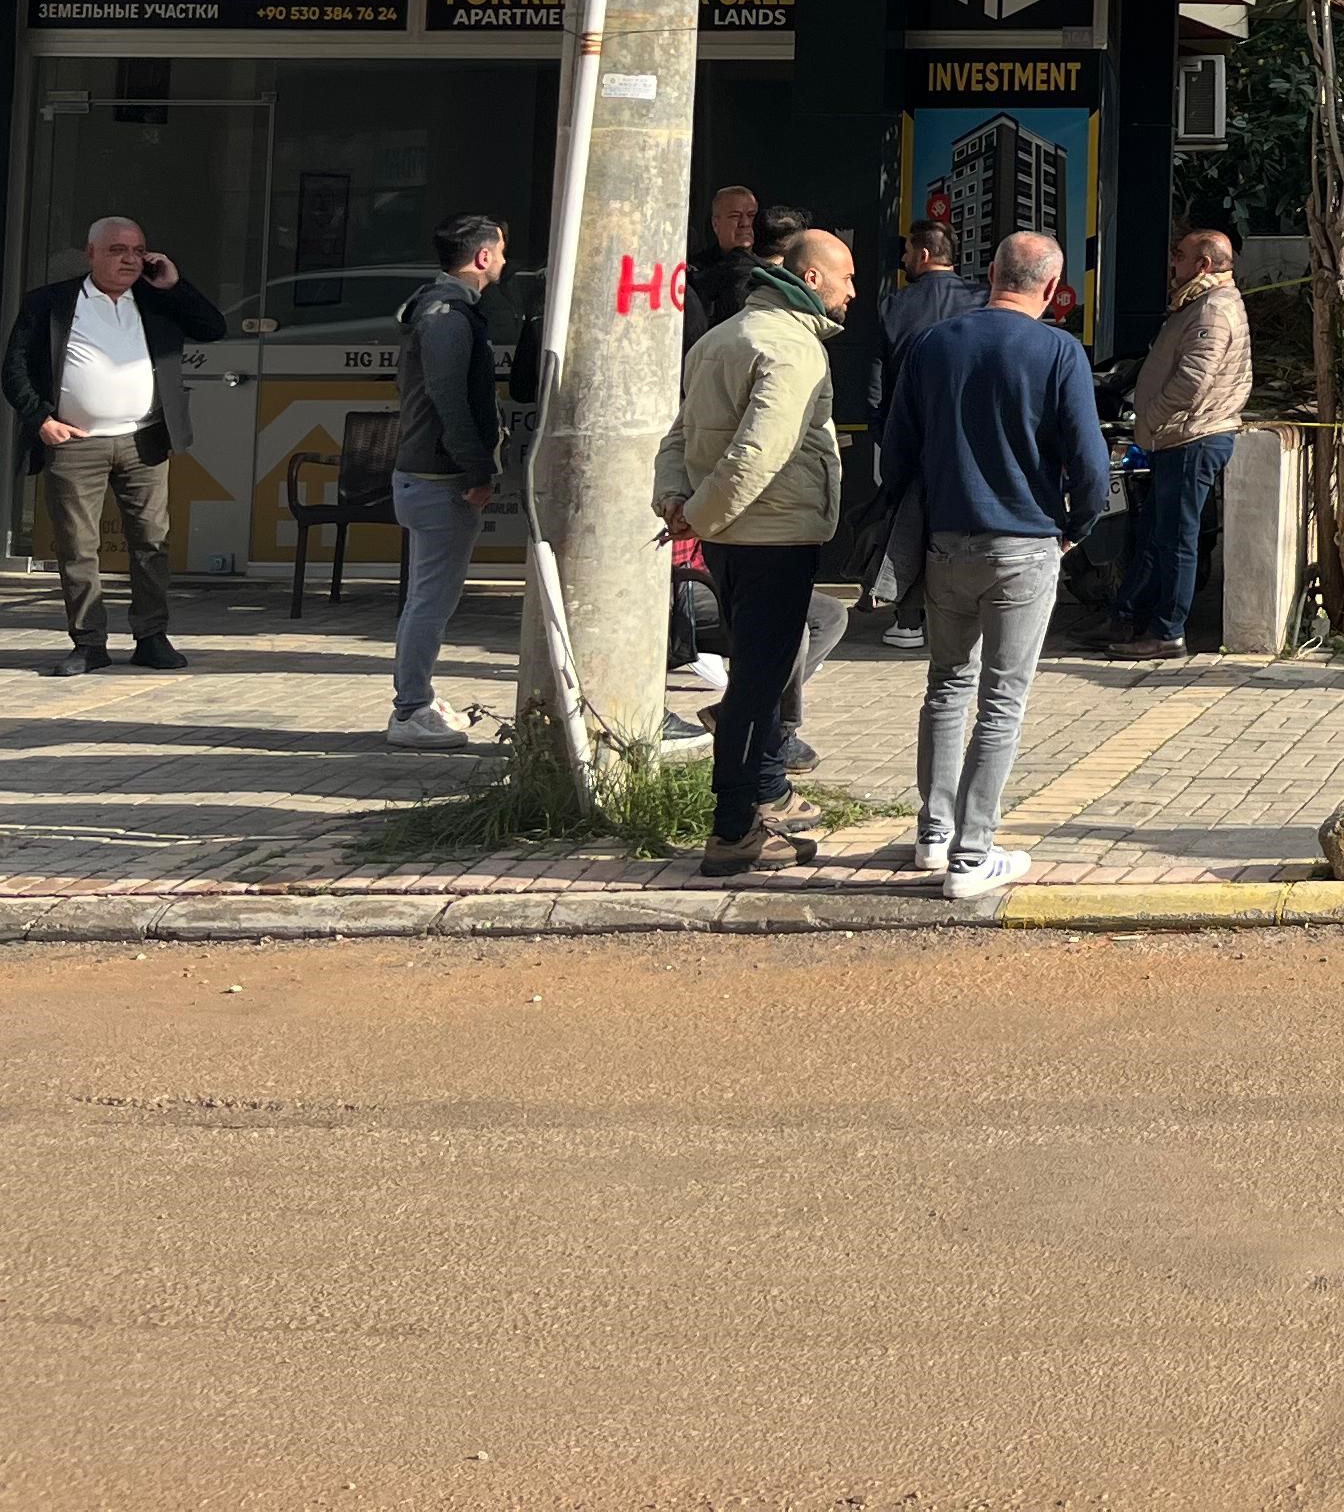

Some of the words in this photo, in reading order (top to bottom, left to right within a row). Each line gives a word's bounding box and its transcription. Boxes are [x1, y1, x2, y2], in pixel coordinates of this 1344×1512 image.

[38, 4, 139, 19] ЗЕМЕЛЬНЫЕ
[143, 4, 219, 20] УЧАСТКИ
[256, 7, 286, 21] +90
[289, 7, 319, 21] 530
[323, 7, 352, 21] 384
[356, 7, 374, 21] 76
[377, 7, 398, 21] 24
[452, 9, 562, 25] APARTME
[713, 9, 787, 25] LANDS
[928, 62, 1081, 92] INVESTMENT
[345, 351, 373, 368] HG
